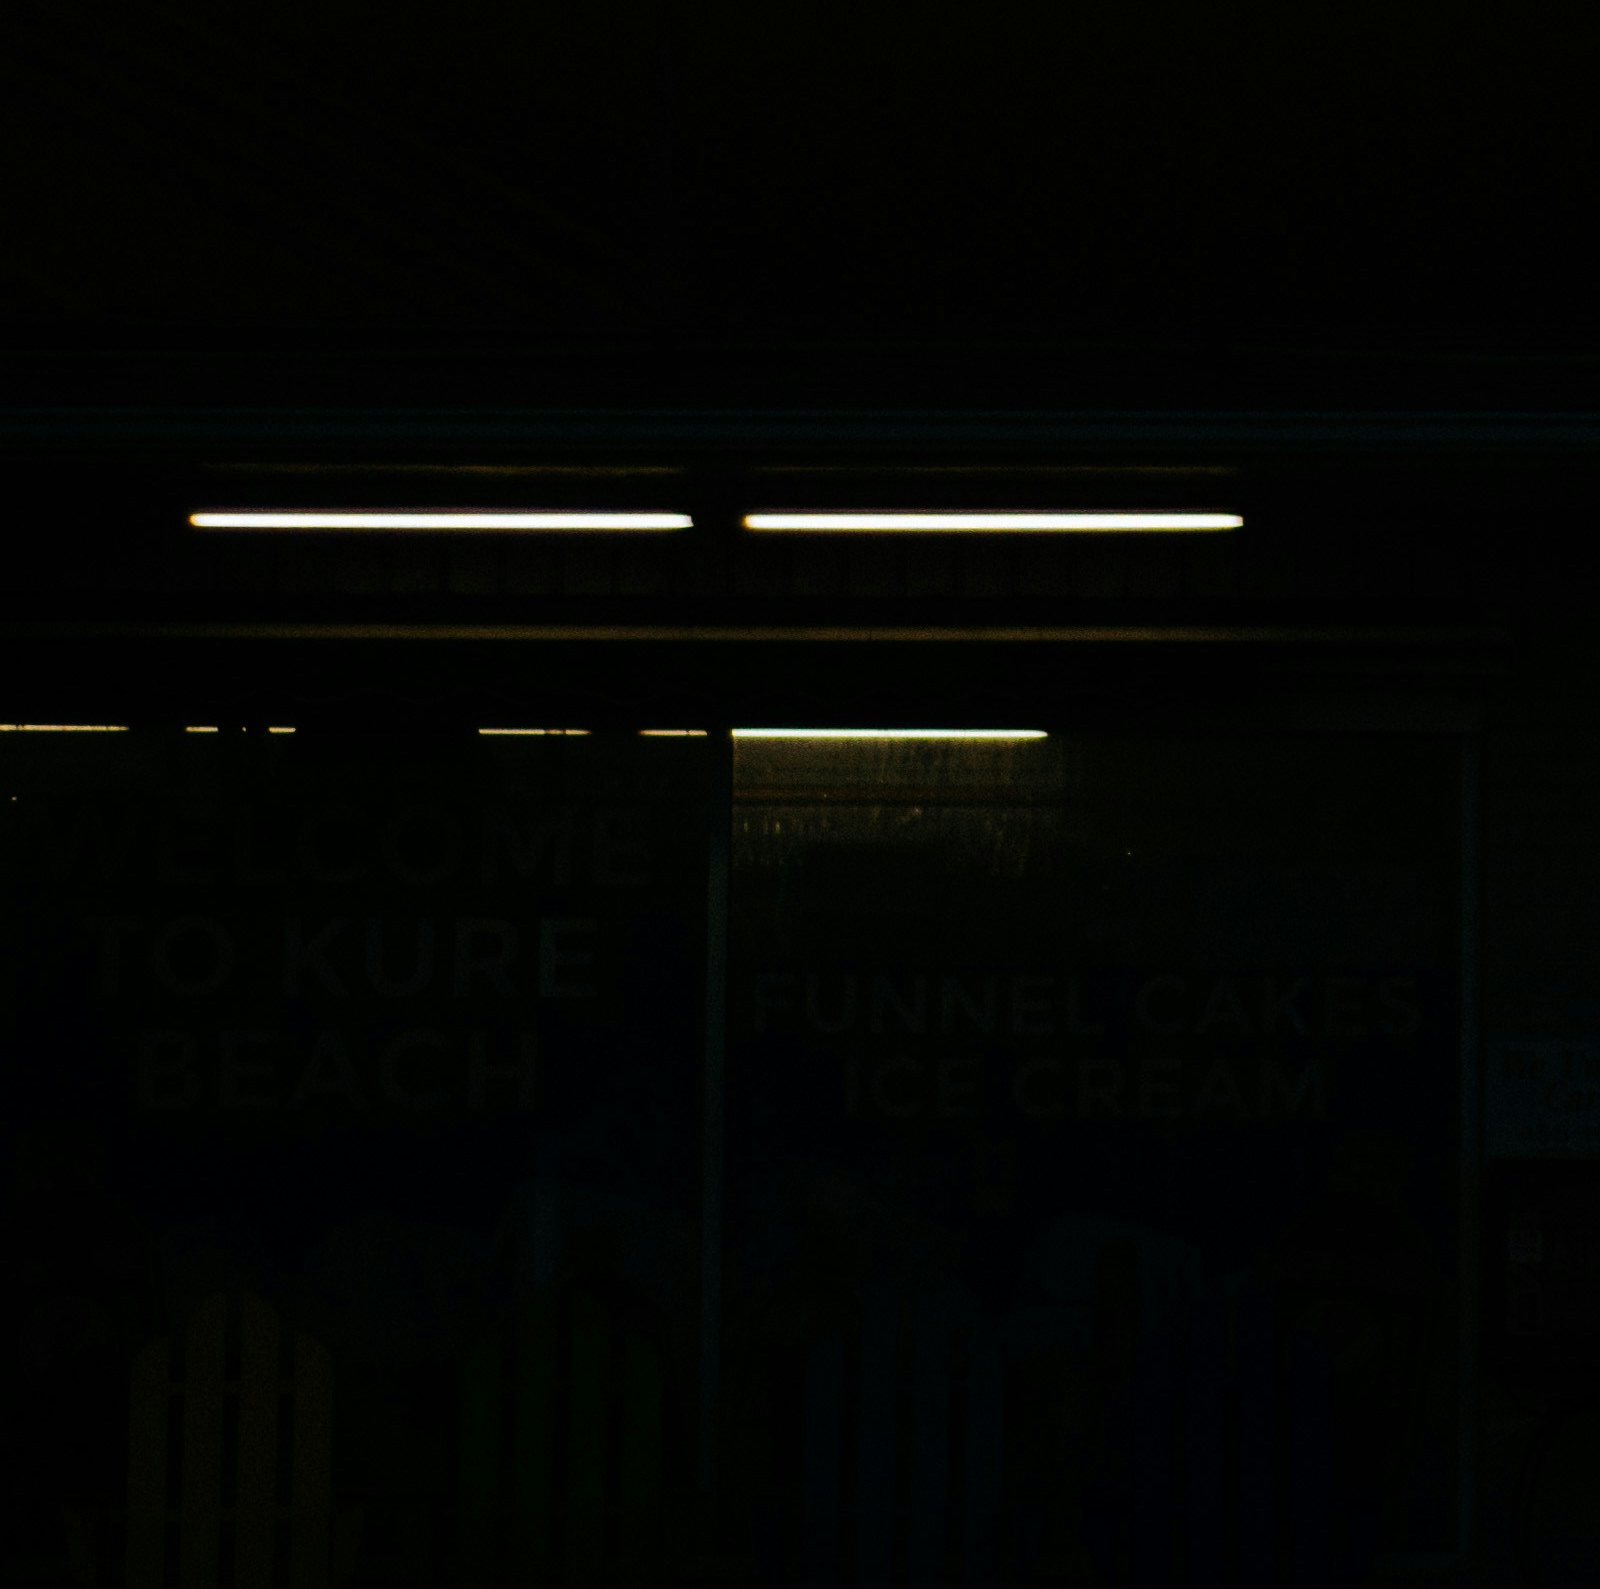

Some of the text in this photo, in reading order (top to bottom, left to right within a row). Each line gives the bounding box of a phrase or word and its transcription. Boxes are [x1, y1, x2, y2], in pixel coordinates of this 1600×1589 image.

[37, 803, 655, 888] WELCOME
[80, 912, 599, 1001] TO KURE
[751, 972, 1425, 1038] FUNNEL CAKES
[136, 1026, 541, 1113] BEACH
[842, 1053, 1329, 1120] ICE CREAM
